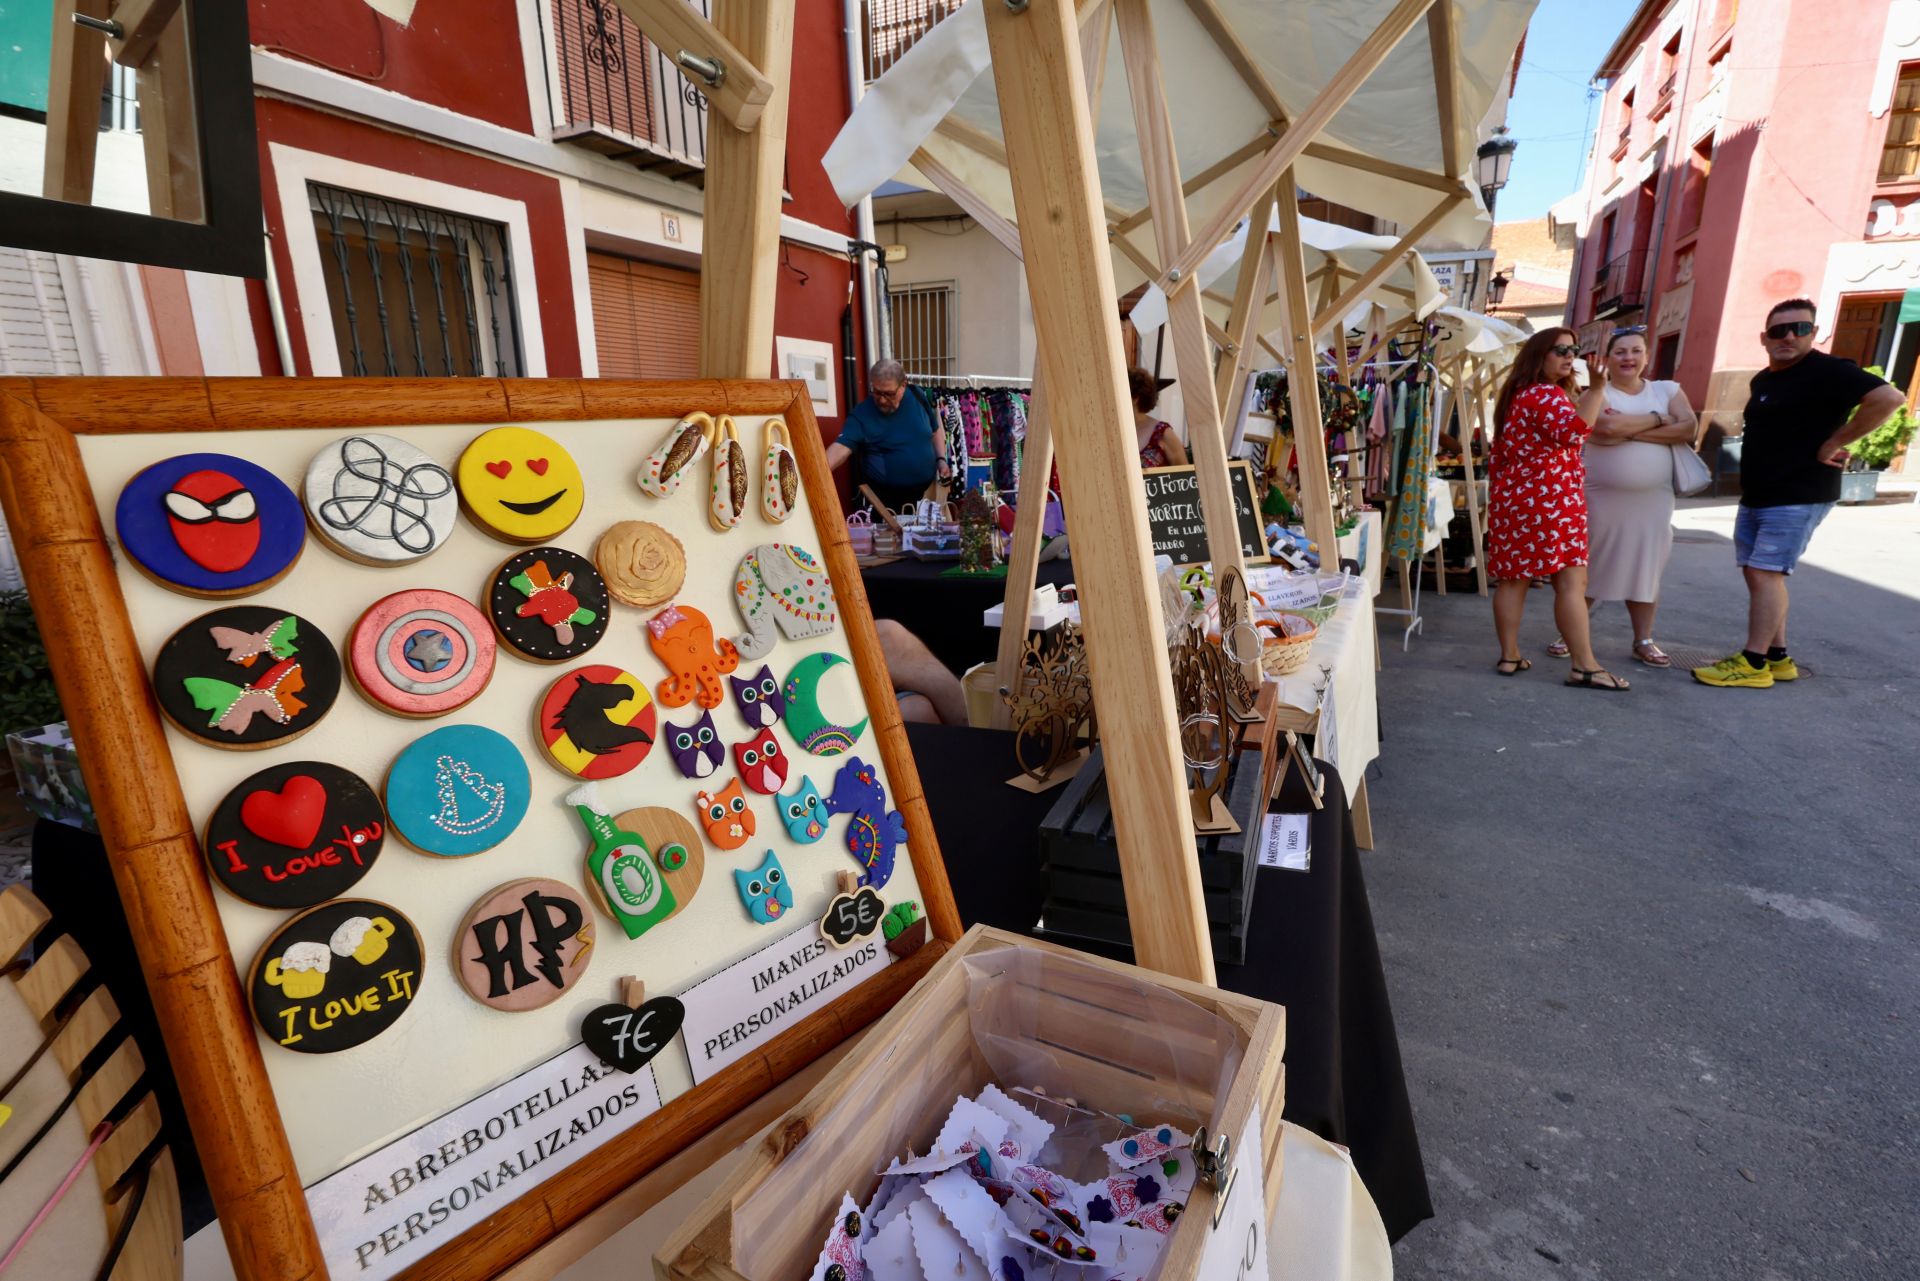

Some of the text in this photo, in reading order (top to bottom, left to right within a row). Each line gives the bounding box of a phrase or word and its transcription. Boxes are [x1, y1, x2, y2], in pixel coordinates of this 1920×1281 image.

[668, 219, 675, 236] 6
[1430, 266, 1452, 274] LAZA
[1268, 590, 1303, 602] LLAVEROS
[216, 839, 249, 873] I
[262, 846, 343, 883] LOVE
[1266, 815, 1281, 864] MARCOS SOPORTES
[1287, 831, 1298, 849] VARIOS
[837, 897, 877, 936] 5€
[471, 890, 583, 999] HP
[750, 937, 828, 994] IMANES
[279, 968, 414, 1046] I LOVE IT
[702, 942, 878, 1061] PERSONALIZADOS
[601, 1009, 658, 1060] 7€
[362, 1059, 616, 1215] ABREBOTELLAS
[354, 1083, 640, 1271] PERSONALIZADOS
